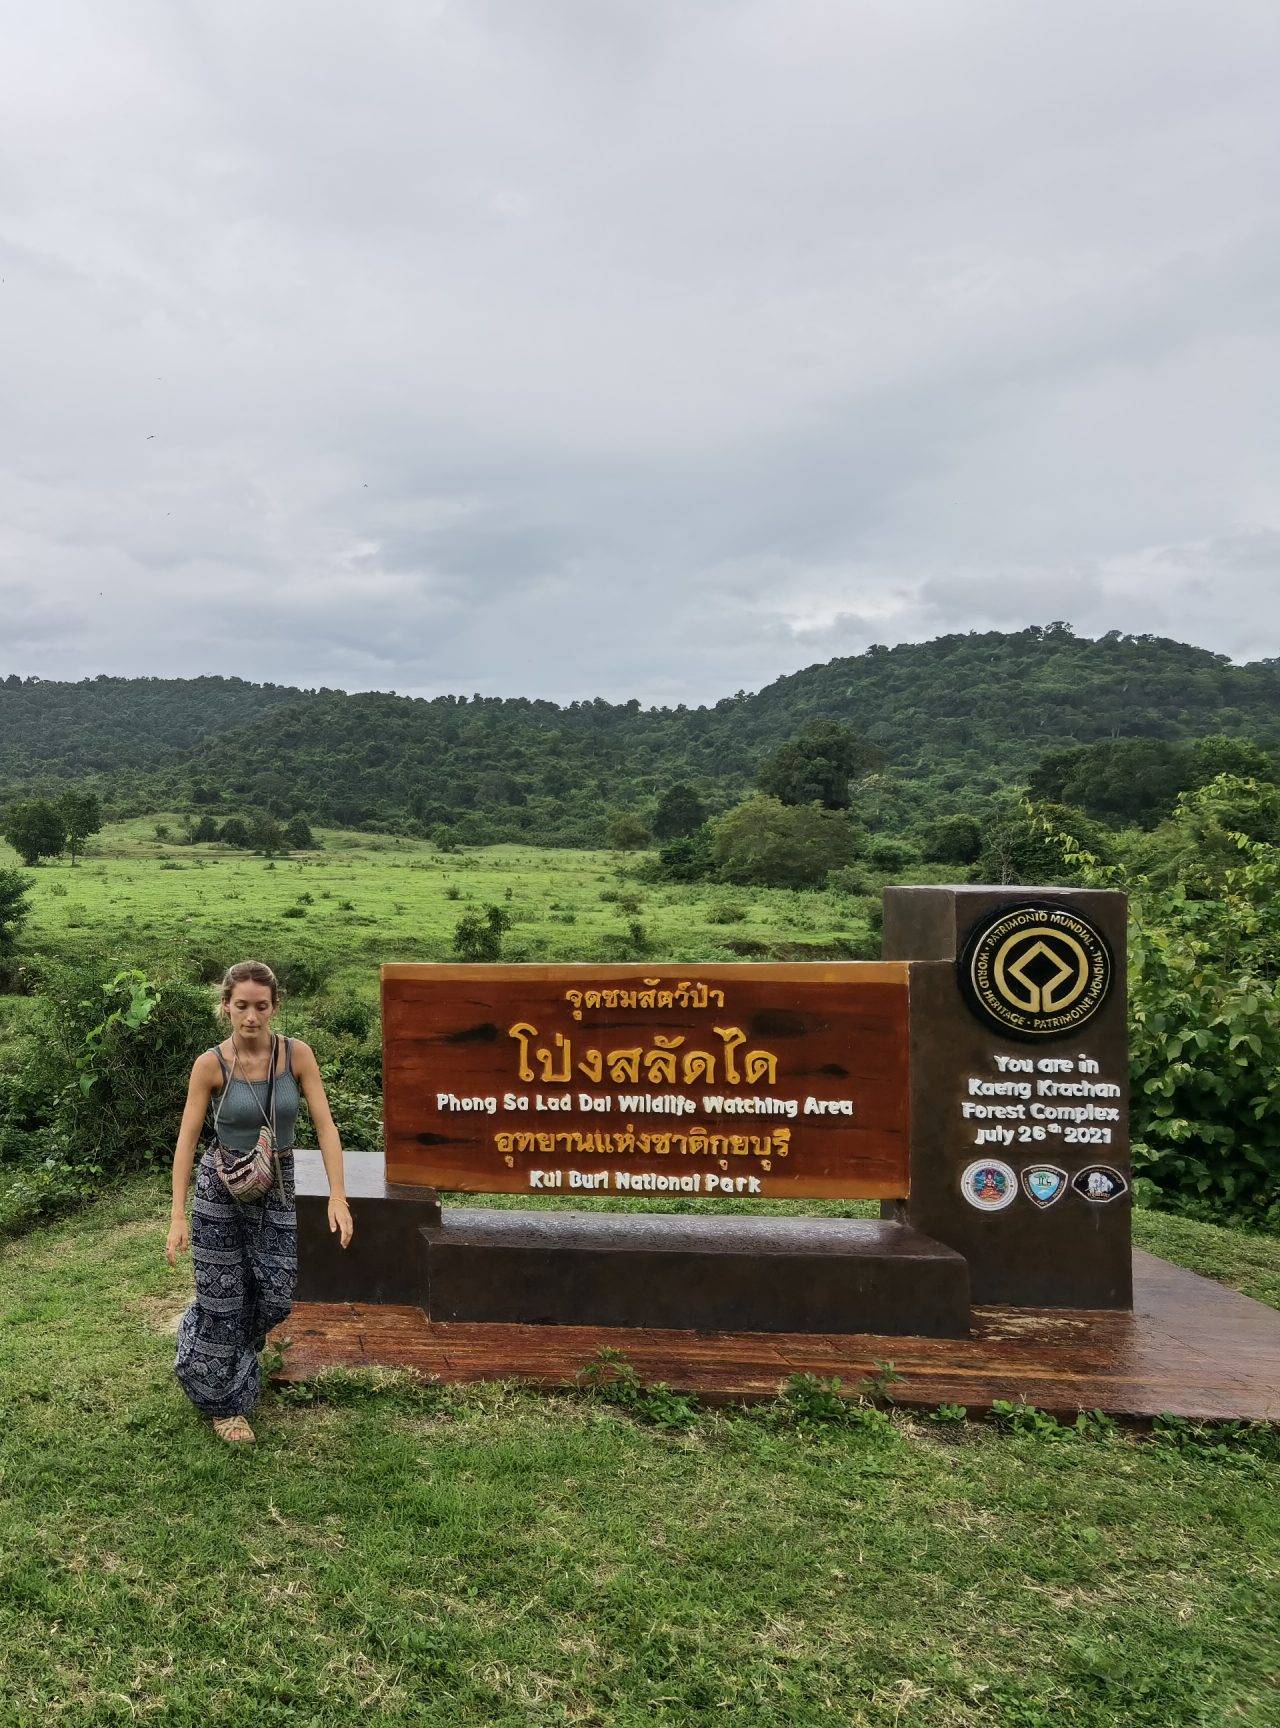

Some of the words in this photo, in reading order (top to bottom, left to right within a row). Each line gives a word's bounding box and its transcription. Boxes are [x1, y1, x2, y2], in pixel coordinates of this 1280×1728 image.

[987, 912, 1048, 946] PATRIMONIO
[1050, 914, 1094, 945] MUNDIAL
[977, 952, 990, 989] WORLD
[565, 977, 725, 1021] จุดชมสัตว์ป่า
[983, 987, 1025, 1025] HERITAGE
[1033, 997, 1094, 1028] PATRIMOINE
[1091, 950, 1104, 998] MONDIAL
[509, 1022, 779, 1085] โป่งสลัดได
[994, 1055, 1033, 1074] You
[1037, 1059, 1073, 1074] are
[1078, 1053, 1099, 1074] in
[436, 1093, 497, 1115] Phong
[503, 1093, 529, 1111] Sa
[535, 1093, 572, 1111] Lad
[578, 1093, 612, 1112] Dai
[617, 1093, 697, 1116] Wildlife
[703, 1095, 798, 1118] Watching
[803, 1096, 854, 1116] Area
[968, 1078, 1032, 1099] Kaeng
[1036, 1079, 1121, 1098] Krachan
[962, 1102, 1026, 1119] Forest
[1030, 1102, 1120, 1124] Complex
[494, 1123, 792, 1171] อุทยานแห่งชาติกุยบุรี
[974, 1125, 1015, 1146] July
[1018, 1122, 1062, 1143] 26th
[1064, 1126, 1112, 1144] 2021
[529, 1170, 562, 1188] Kui
[568, 1170, 609, 1189] Buri
[614, 1170, 701, 1192] National
[704, 1172, 761, 1193] Park
